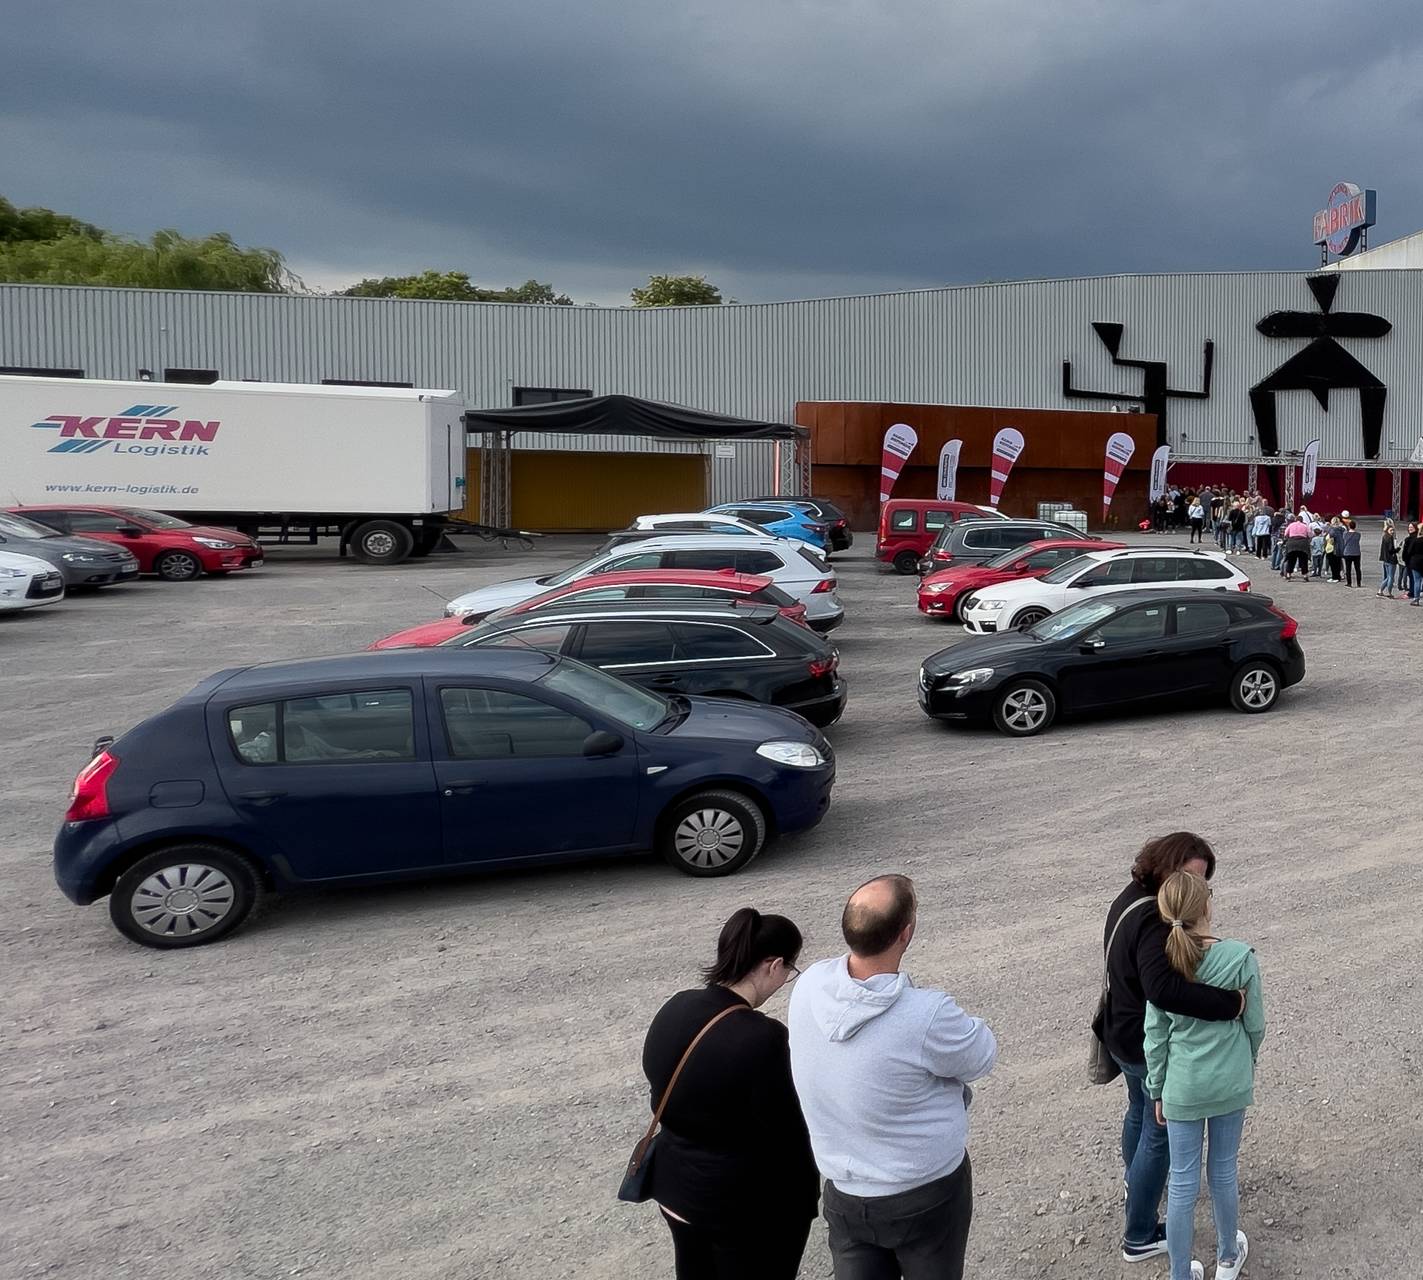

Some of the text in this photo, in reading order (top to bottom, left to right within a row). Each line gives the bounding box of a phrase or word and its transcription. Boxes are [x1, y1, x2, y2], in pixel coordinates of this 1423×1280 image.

[1314, 196, 1365, 241] FABRIK
[45, 415, 221, 442] KERN
[113, 442, 209, 456] Logistik
[45, 483, 200, 495] www.kern-logistik.de
